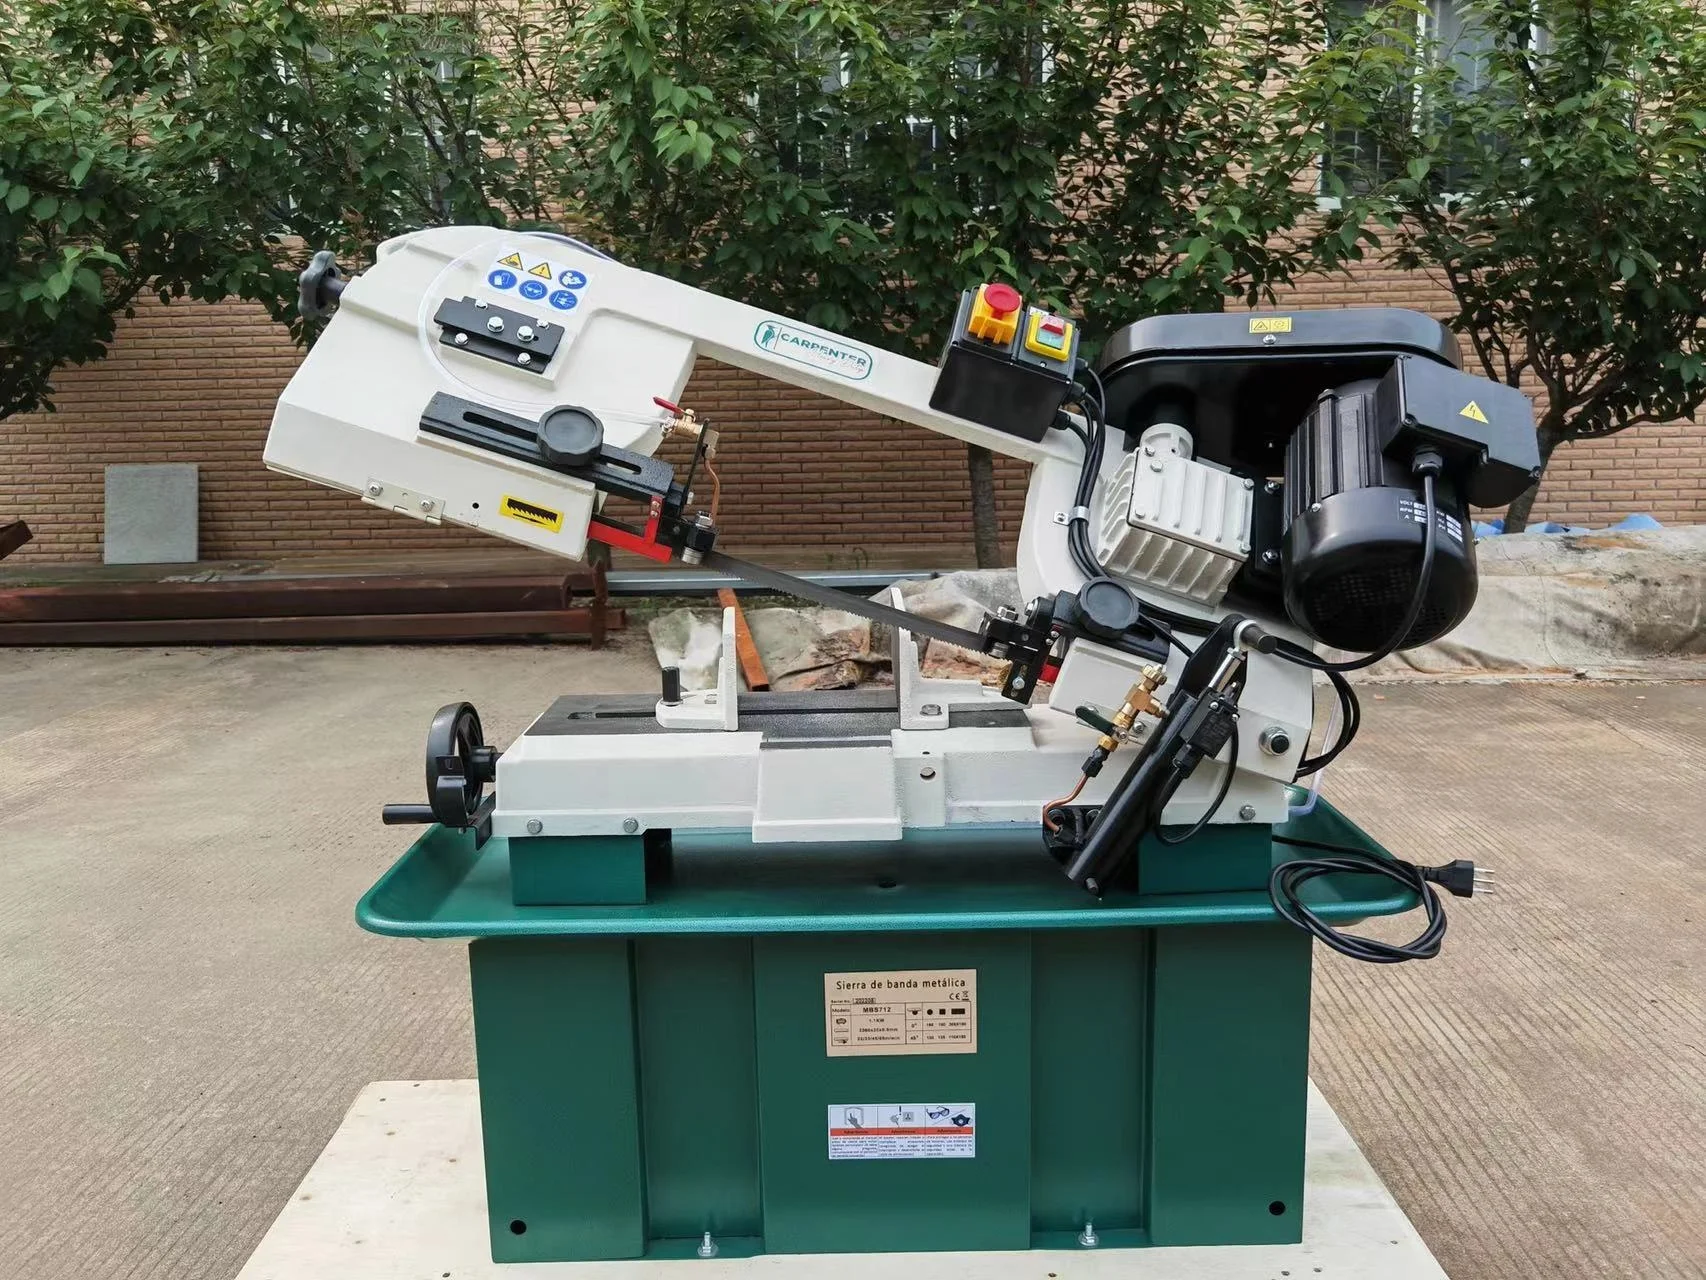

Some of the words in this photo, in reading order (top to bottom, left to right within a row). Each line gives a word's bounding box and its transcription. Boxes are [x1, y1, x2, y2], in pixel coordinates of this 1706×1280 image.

[781, 333, 867, 366] CARPENTER
[836, 980, 866, 990] Sierra
[870, 979, 883, 989] de
[887, 979, 918, 989] banda
[922, 978, 966, 988] metálica
